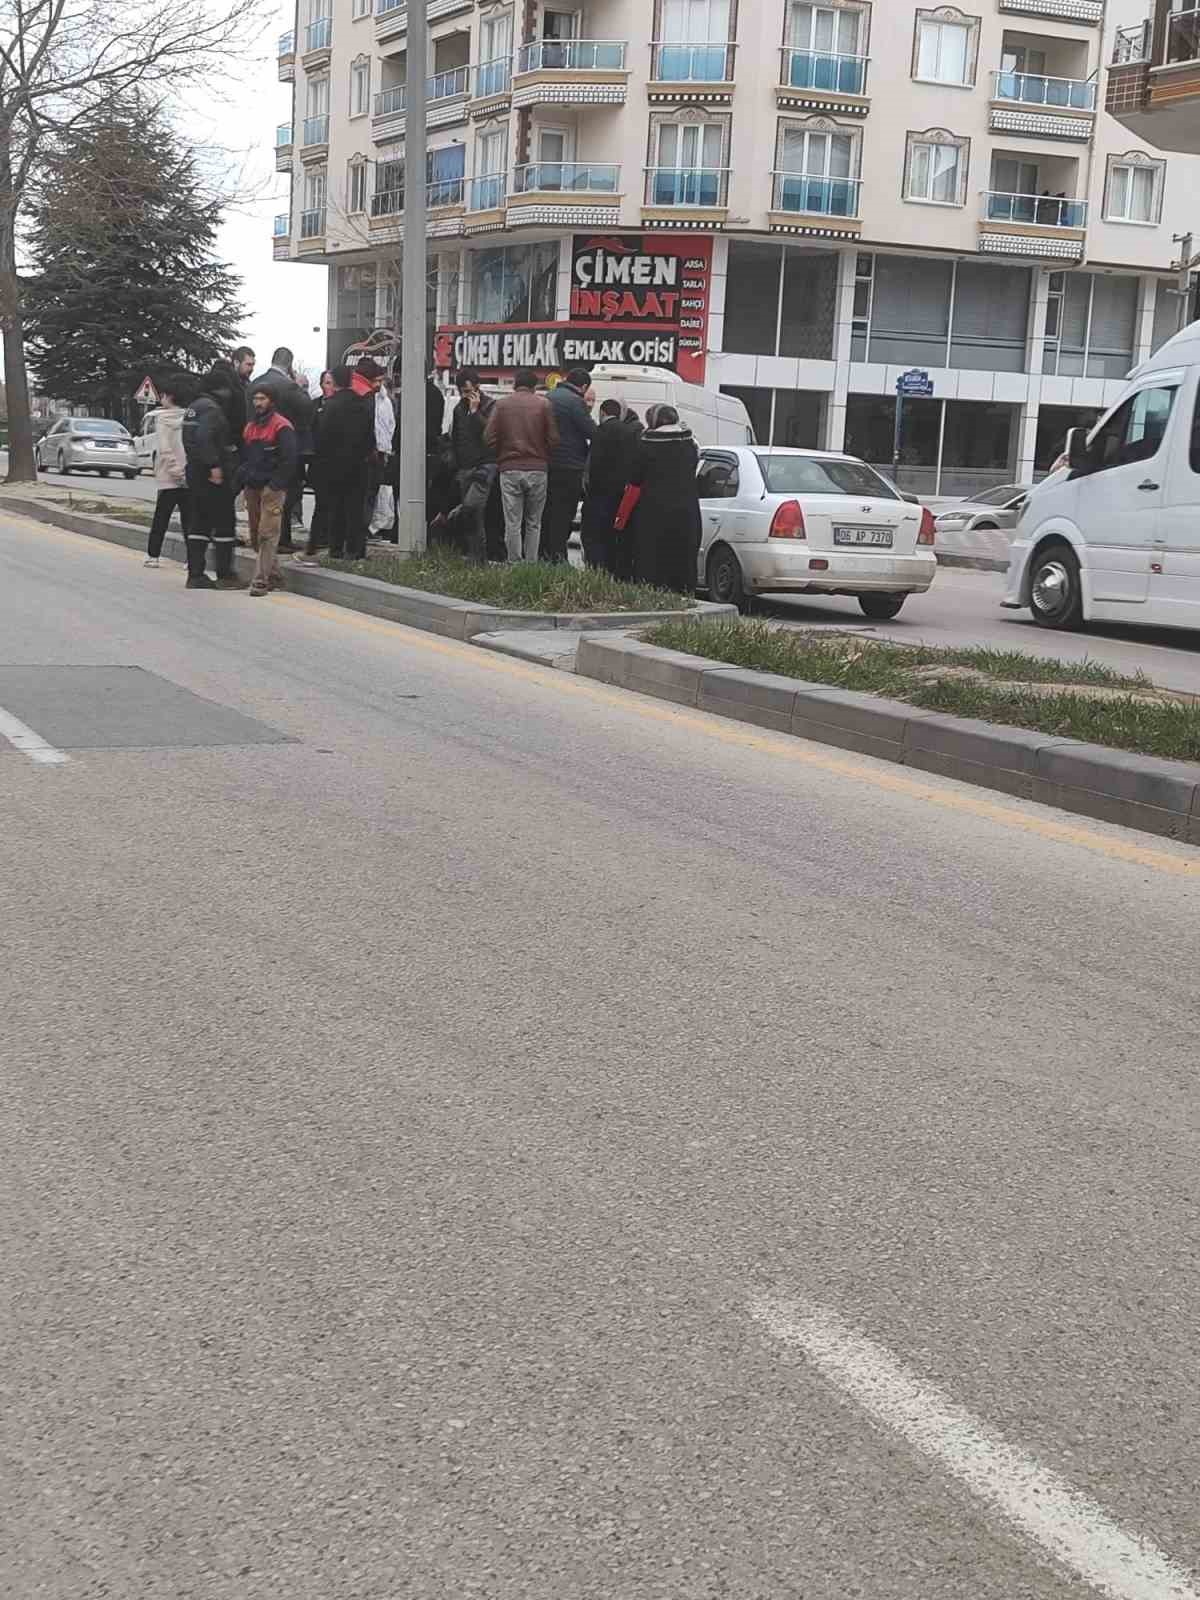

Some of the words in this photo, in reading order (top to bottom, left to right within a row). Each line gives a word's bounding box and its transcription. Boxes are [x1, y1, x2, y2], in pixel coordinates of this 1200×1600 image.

[576, 249, 677, 289] ÇİMEN
[684, 260, 704, 269] ARSA
[682, 280, 703, 289] TARLA
[571, 288, 679, 320] İNŞAAT
[680, 318, 701, 328] DAİRE
[455, 331, 499, 370] ÇİMEN
[503, 332, 560, 367] EMLAK
[563, 339, 625, 362] EMLAK
[629, 337, 674, 364] OFİSİ
[856, 531, 866, 541] AP
[871, 532, 891, 543] 7370
